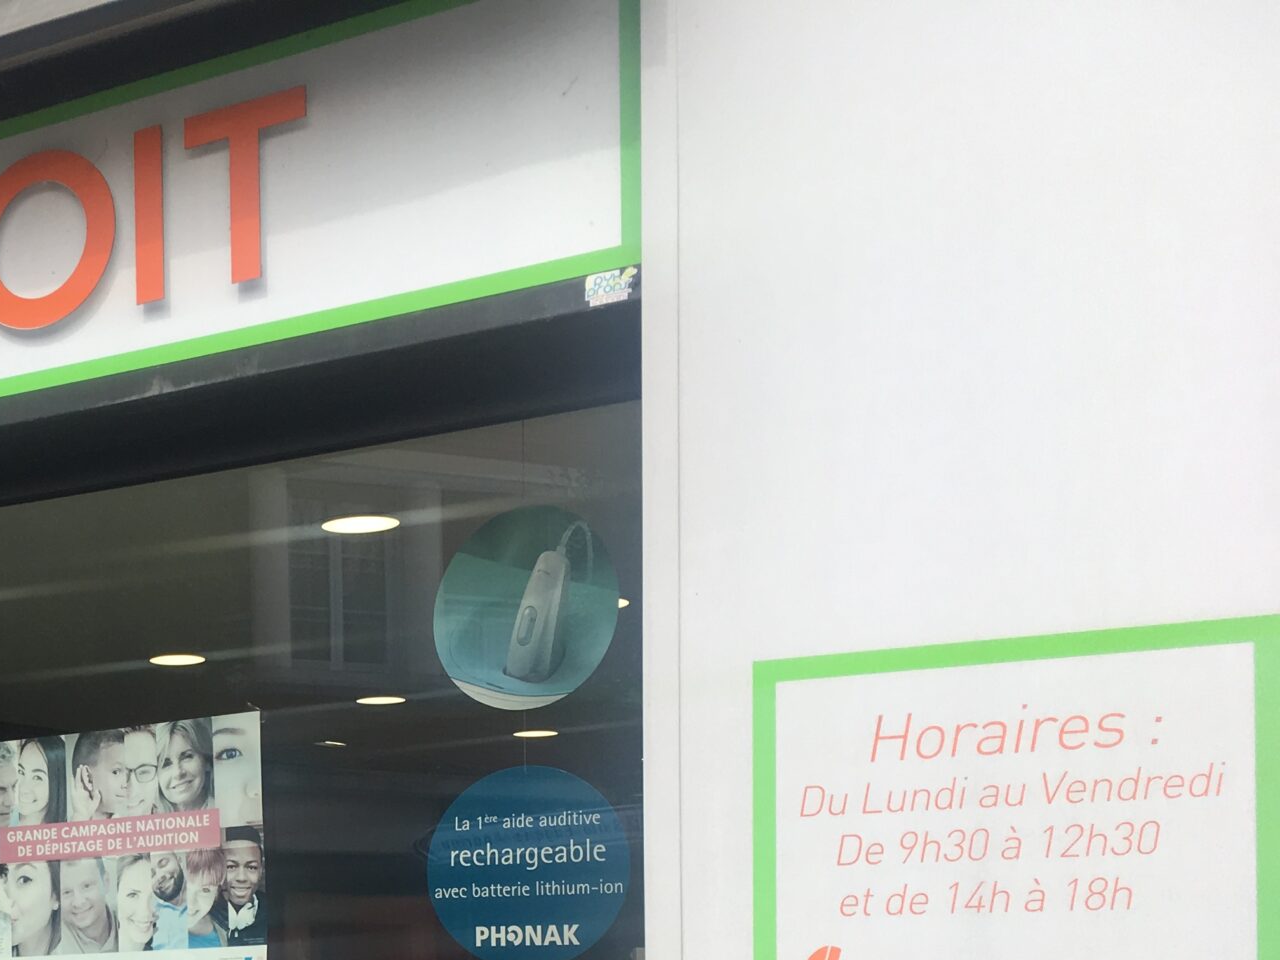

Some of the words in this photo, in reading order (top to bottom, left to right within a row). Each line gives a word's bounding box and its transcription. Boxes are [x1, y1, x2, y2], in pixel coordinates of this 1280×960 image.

[869, 703, 1127, 763] Horaires
[799, 784, 848, 818] Du
[861, 776, 970, 815] Lundi
[979, 781, 1026, 809] au
[1042, 761, 1227, 806] Vendredi
[7, 828, 58, 843] GRANDE
[61, 821, 133, 839] CAMPAGNE
[136, 814, 211, 834] NATIONALE
[455, 816, 470, 831] La
[502, 813, 534, 829] aide
[539, 810, 601, 827] auditive
[17, 845, 33, 857] DE
[36, 840, 103, 856] DÉPISTAGE
[107, 838, 123, 851] DE
[126, 831, 199, 849] L'AUDITION
[450, 838, 607, 870] rechargeable
[836, 834, 885, 867] De
[898, 828, 990, 865] 9h30
[1001, 826, 1023, 860] à
[1042, 820, 1161, 859] 12h30
[434, 886, 468, 899] avec
[472, 882, 530, 898] batterie
[535, 879, 624, 896] lithium-ion
[839, 887, 874, 917] et
[885, 884, 929, 917] de
[947, 880, 1011, 914] 14h
[1023, 878, 1045, 913] à
[1067, 876, 1134, 912] 18h
[475, 924, 580, 947] PHONAK
